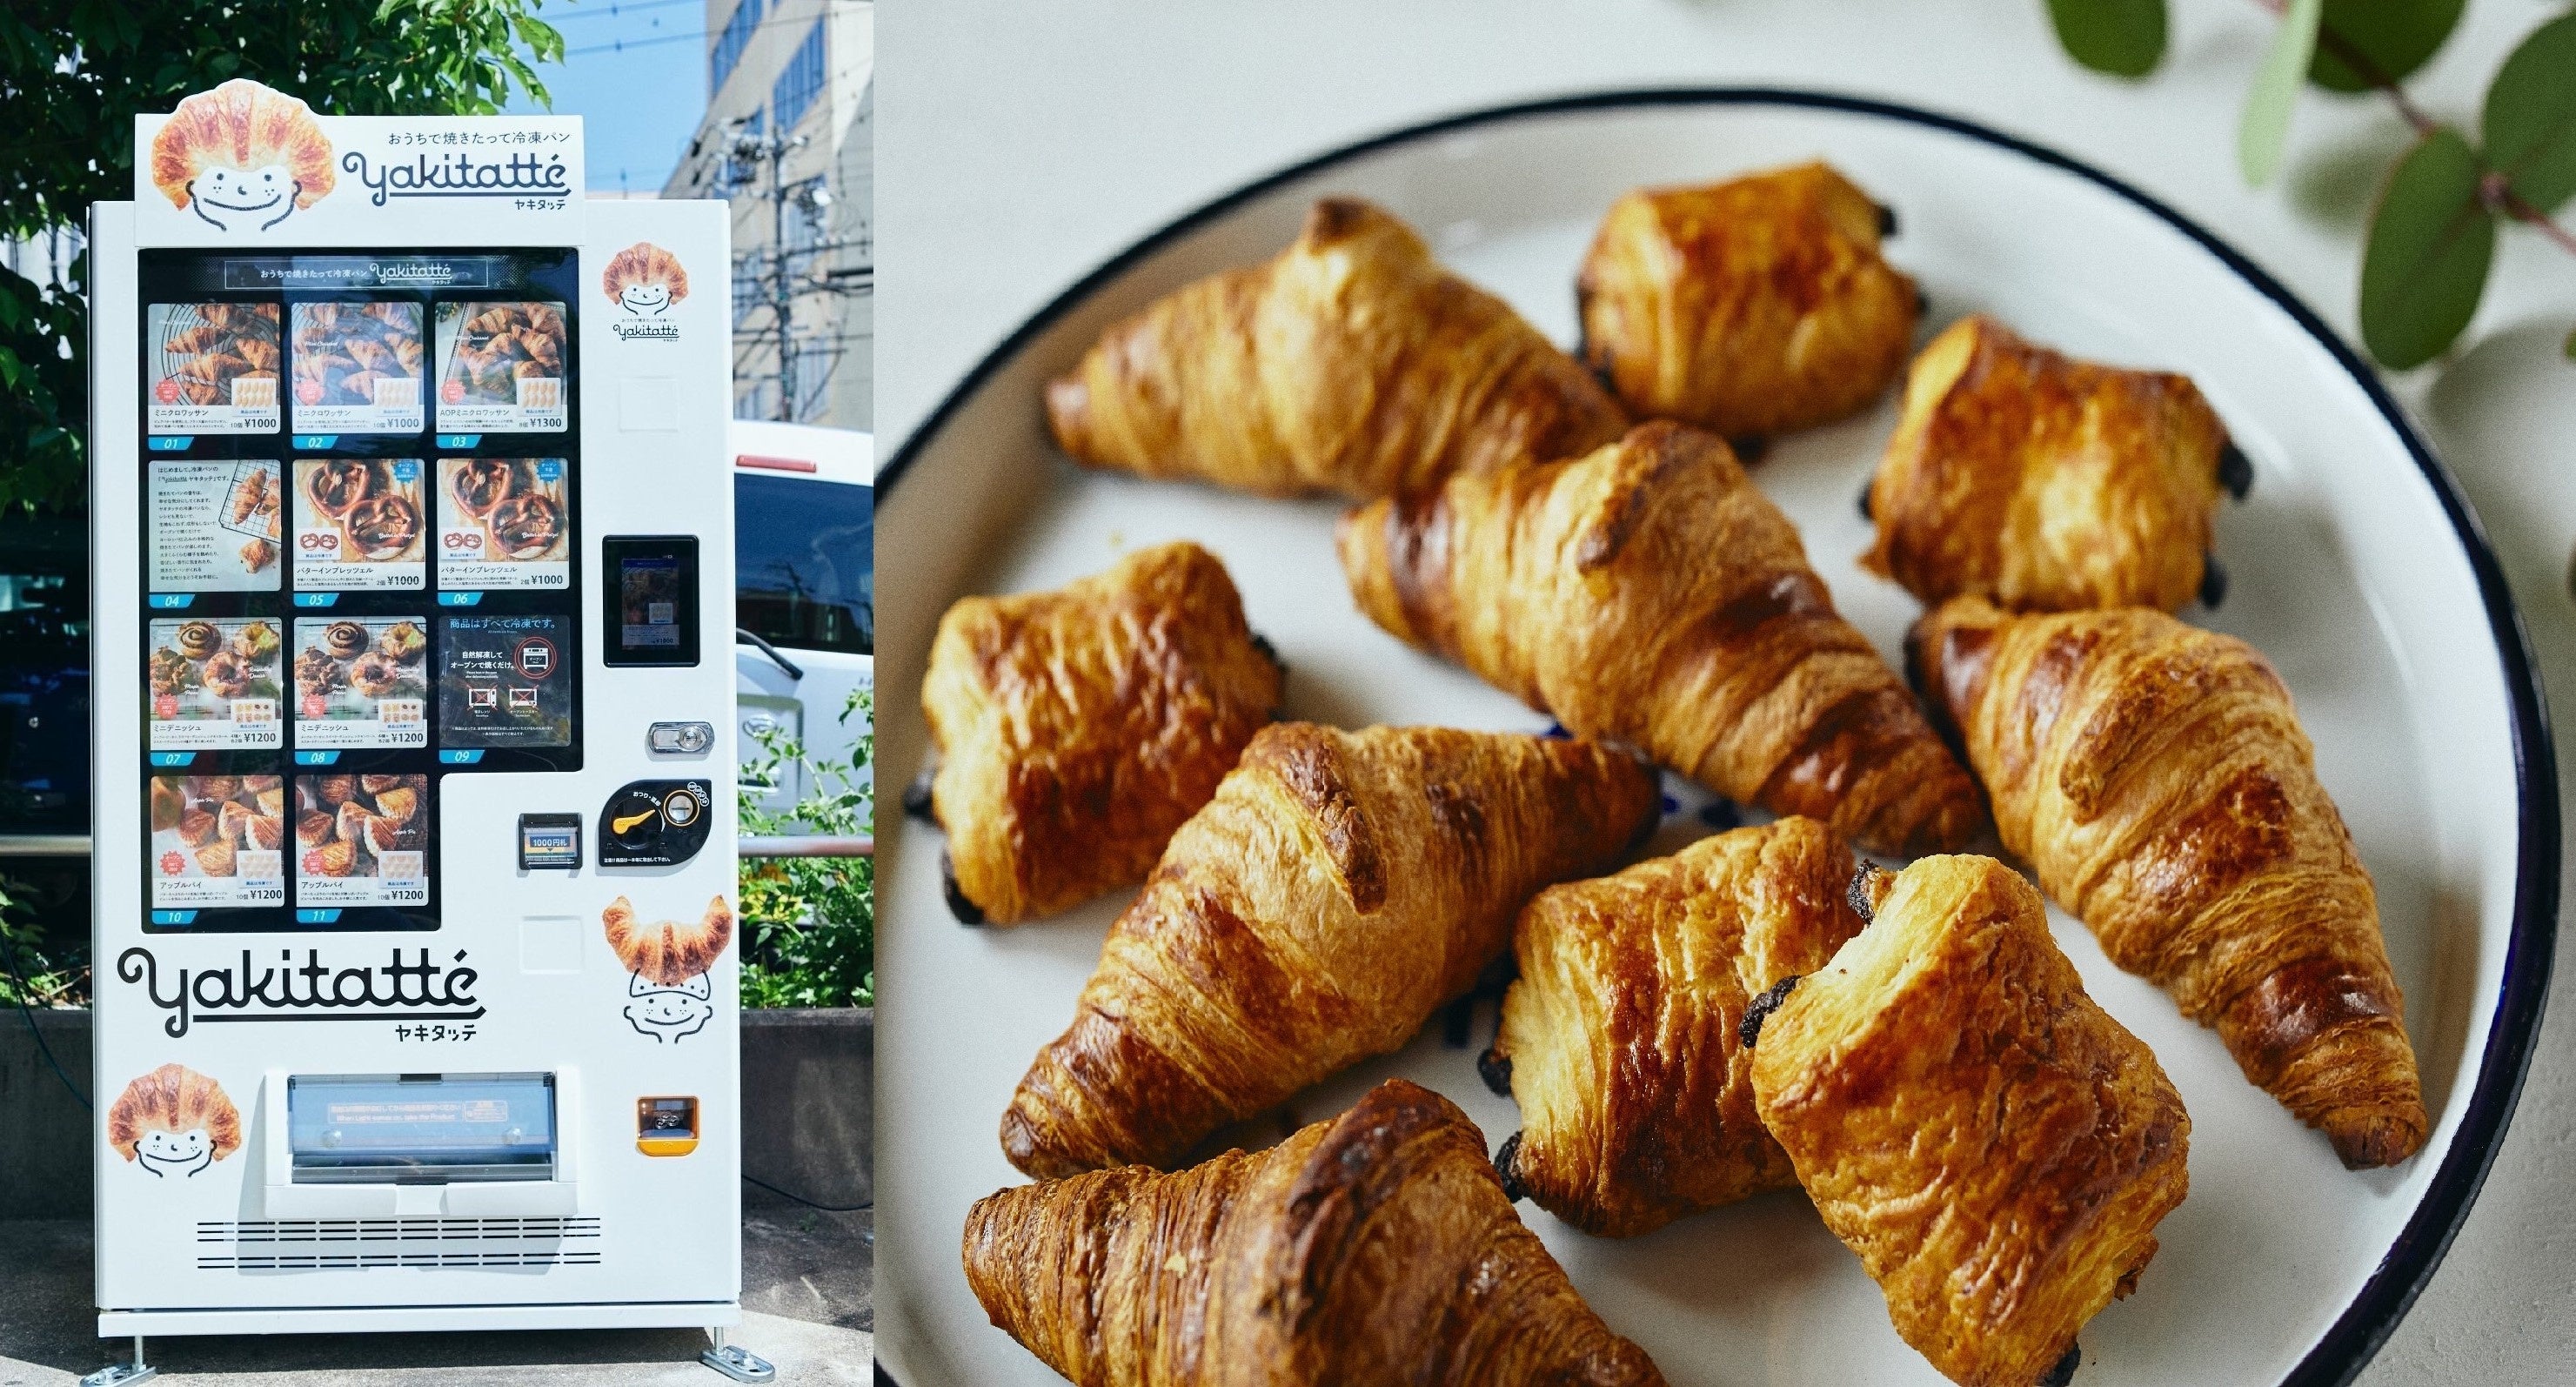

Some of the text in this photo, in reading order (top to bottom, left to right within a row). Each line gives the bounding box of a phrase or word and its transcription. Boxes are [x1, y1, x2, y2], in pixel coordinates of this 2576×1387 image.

[388, 131, 571, 145] おうちで焼きたって冷凍パン
[515, 199, 565, 211] ヤキタッテ
[260, 269, 368, 278] おうちで焼きたって冷凍パン
[244, 419, 277, 428] ¥1000
[387, 418, 419, 428] ¥1000
[530, 418, 562, 427] ¥1300
[164, 439, 178, 449] 01
[308, 438, 323, 448] 02
[452, 437, 466, 447] 03
[387, 576, 419, 586] ¥1000
[531, 575, 563, 585] ¥1000
[164, 595, 179, 606] 04
[309, 594, 324, 606] 05
[453, 594, 468, 604] 06
[450, 618, 555, 629] 商品はすべて冷凍です。
[462, 651, 503, 660] 自然解凍して
[450, 661, 515, 670] オーブンで焼くだけ。
[244, 733, 276, 742] ¥1200
[391, 733, 424, 742] ¥1200
[165, 754, 181, 764] 07
[311, 753, 325, 763] 08
[454, 751, 470, 762] 09
[250, 889, 283, 900] ¥1200
[391, 890, 424, 900] ¥1200
[168, 912, 182, 922] 10
[311, 911, 325, 921] 11
[395, 1024, 477, 1042] ヤキタッテ
